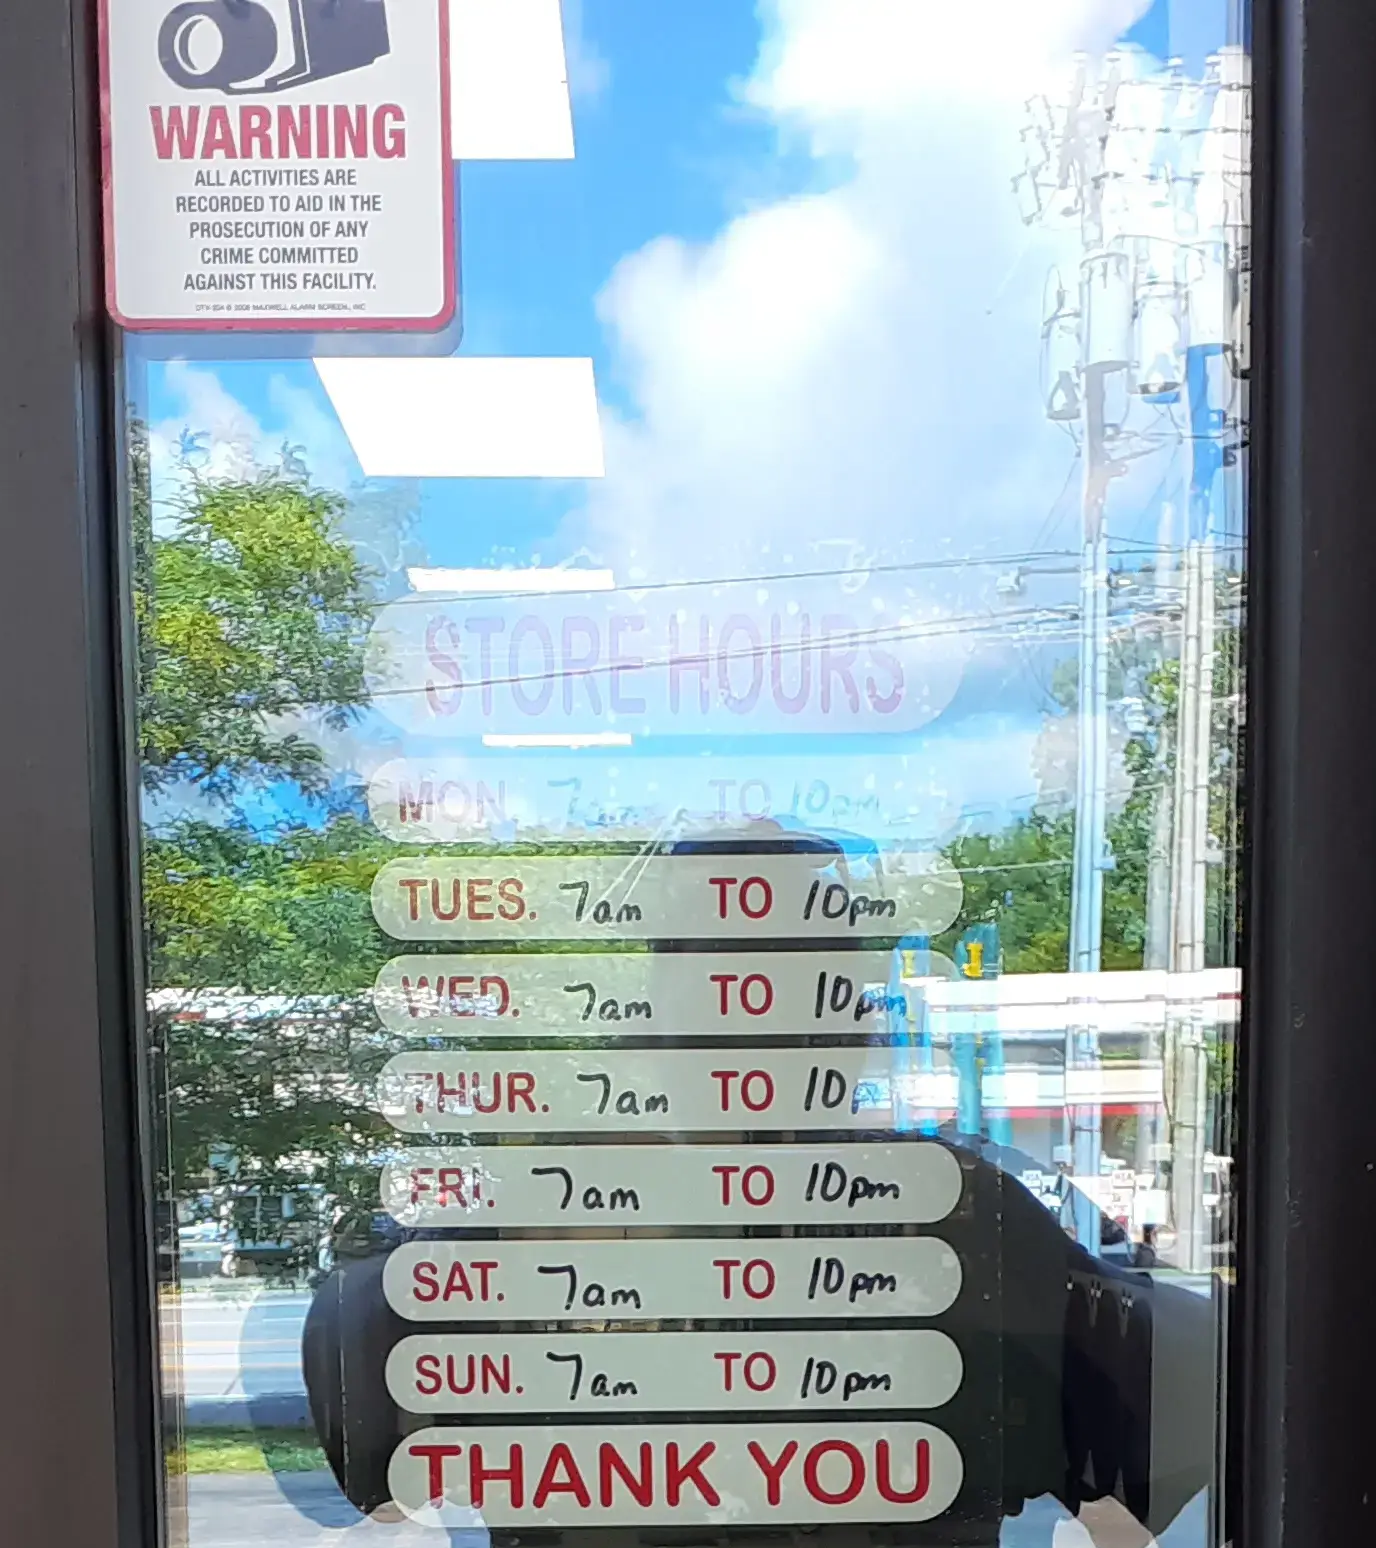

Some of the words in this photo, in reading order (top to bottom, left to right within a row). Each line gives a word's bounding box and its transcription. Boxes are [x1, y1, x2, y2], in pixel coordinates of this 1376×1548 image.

[148, 103, 407, 160] WARNING
[194, 169, 225, 187] ALL
[229, 169, 320, 186] ACTIVITIES
[323, 169, 357, 186] ARE
[175, 195, 265, 213] RECORDED
[269, 195, 291, 212] TO
[295, 195, 324, 211] AID
[328, 195, 345, 212] IN
[349, 195, 382, 212] THE
[189, 221, 305, 239] PROSECUTION
[309, 221, 332, 238] OF
[334, 221, 369, 238] ANY
[200, 247, 254, 265] CRIME
[258, 247, 359, 264] COMMITTED
[183, 273, 256, 291] AGAINST
[260, 273, 297, 290] THIS
[302, 273, 377, 290] FACILITY.
[425, 613, 645, 717] STORE
[668, 610, 906, 715] HOURS
[708, 778, 772, 822] TO
[398, 877, 537, 922] TUES.
[558, 880, 642, 923] 7am
[709, 875, 773, 919] TO
[803, 878, 896, 927] 10pm
[401, 974, 520, 1018] WED.
[563, 981, 652, 1020] 7am
[709, 973, 773, 1016] TO
[814, 970, 908, 1022] 10pm
[404, 1070, 549, 1114] THUR.
[576, 1073, 669, 1116] 7am
[710, 1069, 774, 1113] TO
[409, 1166, 496, 1209] FRI.
[531, 1166, 640, 1211] 7am
[712, 1164, 775, 1206] TO
[804, 1163, 901, 1208] 10pm
[412, 1260, 505, 1303] SAT.
[537, 1264, 642, 1311] 7am
[713, 1258, 776, 1300] TO
[807, 1257, 897, 1300] 10pm
[414, 1353, 524, 1396] SUN.
[546, 1352, 638, 1400] 7am
[714, 1351, 777, 1392] TO
[801, 1357, 891, 1401] 10pm
[408, 1440, 721, 1509] THANK
[747, 1438, 931, 1507] YOU
